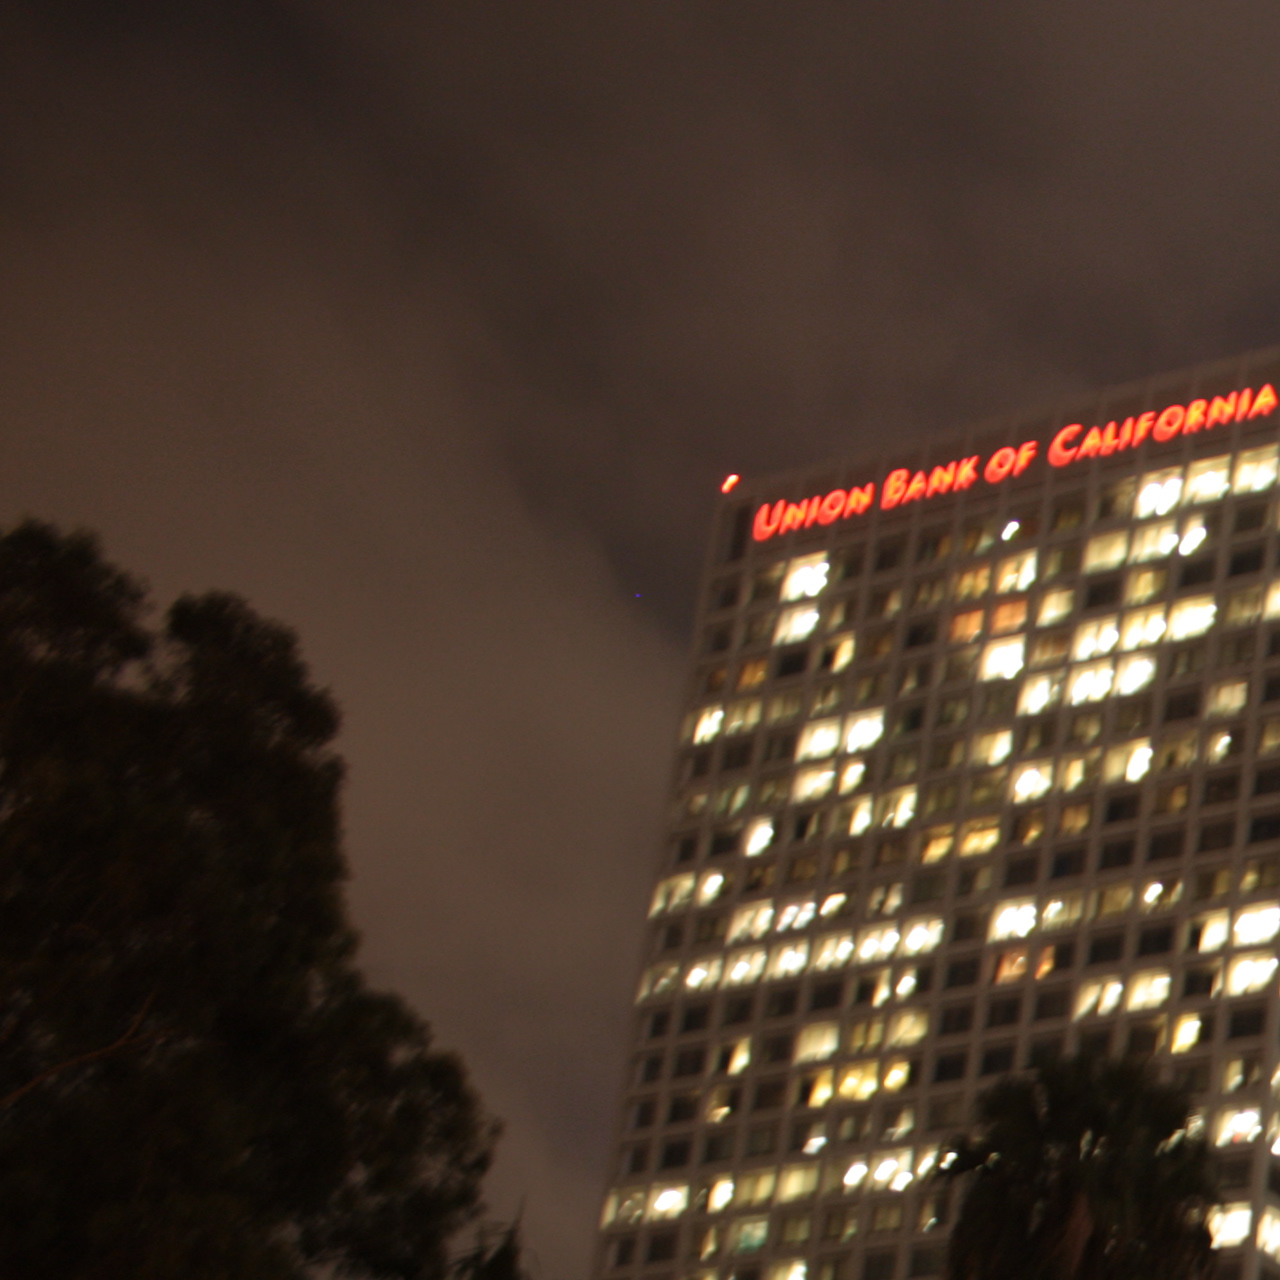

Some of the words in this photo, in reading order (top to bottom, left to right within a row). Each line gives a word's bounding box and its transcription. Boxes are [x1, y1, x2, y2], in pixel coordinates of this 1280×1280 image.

[752, 481, 876, 542] UNION
[879, 454, 981, 511] BANK
[983, 439, 1039, 484] OF
[1046, 383, 1280, 468] CALIFORNIA
